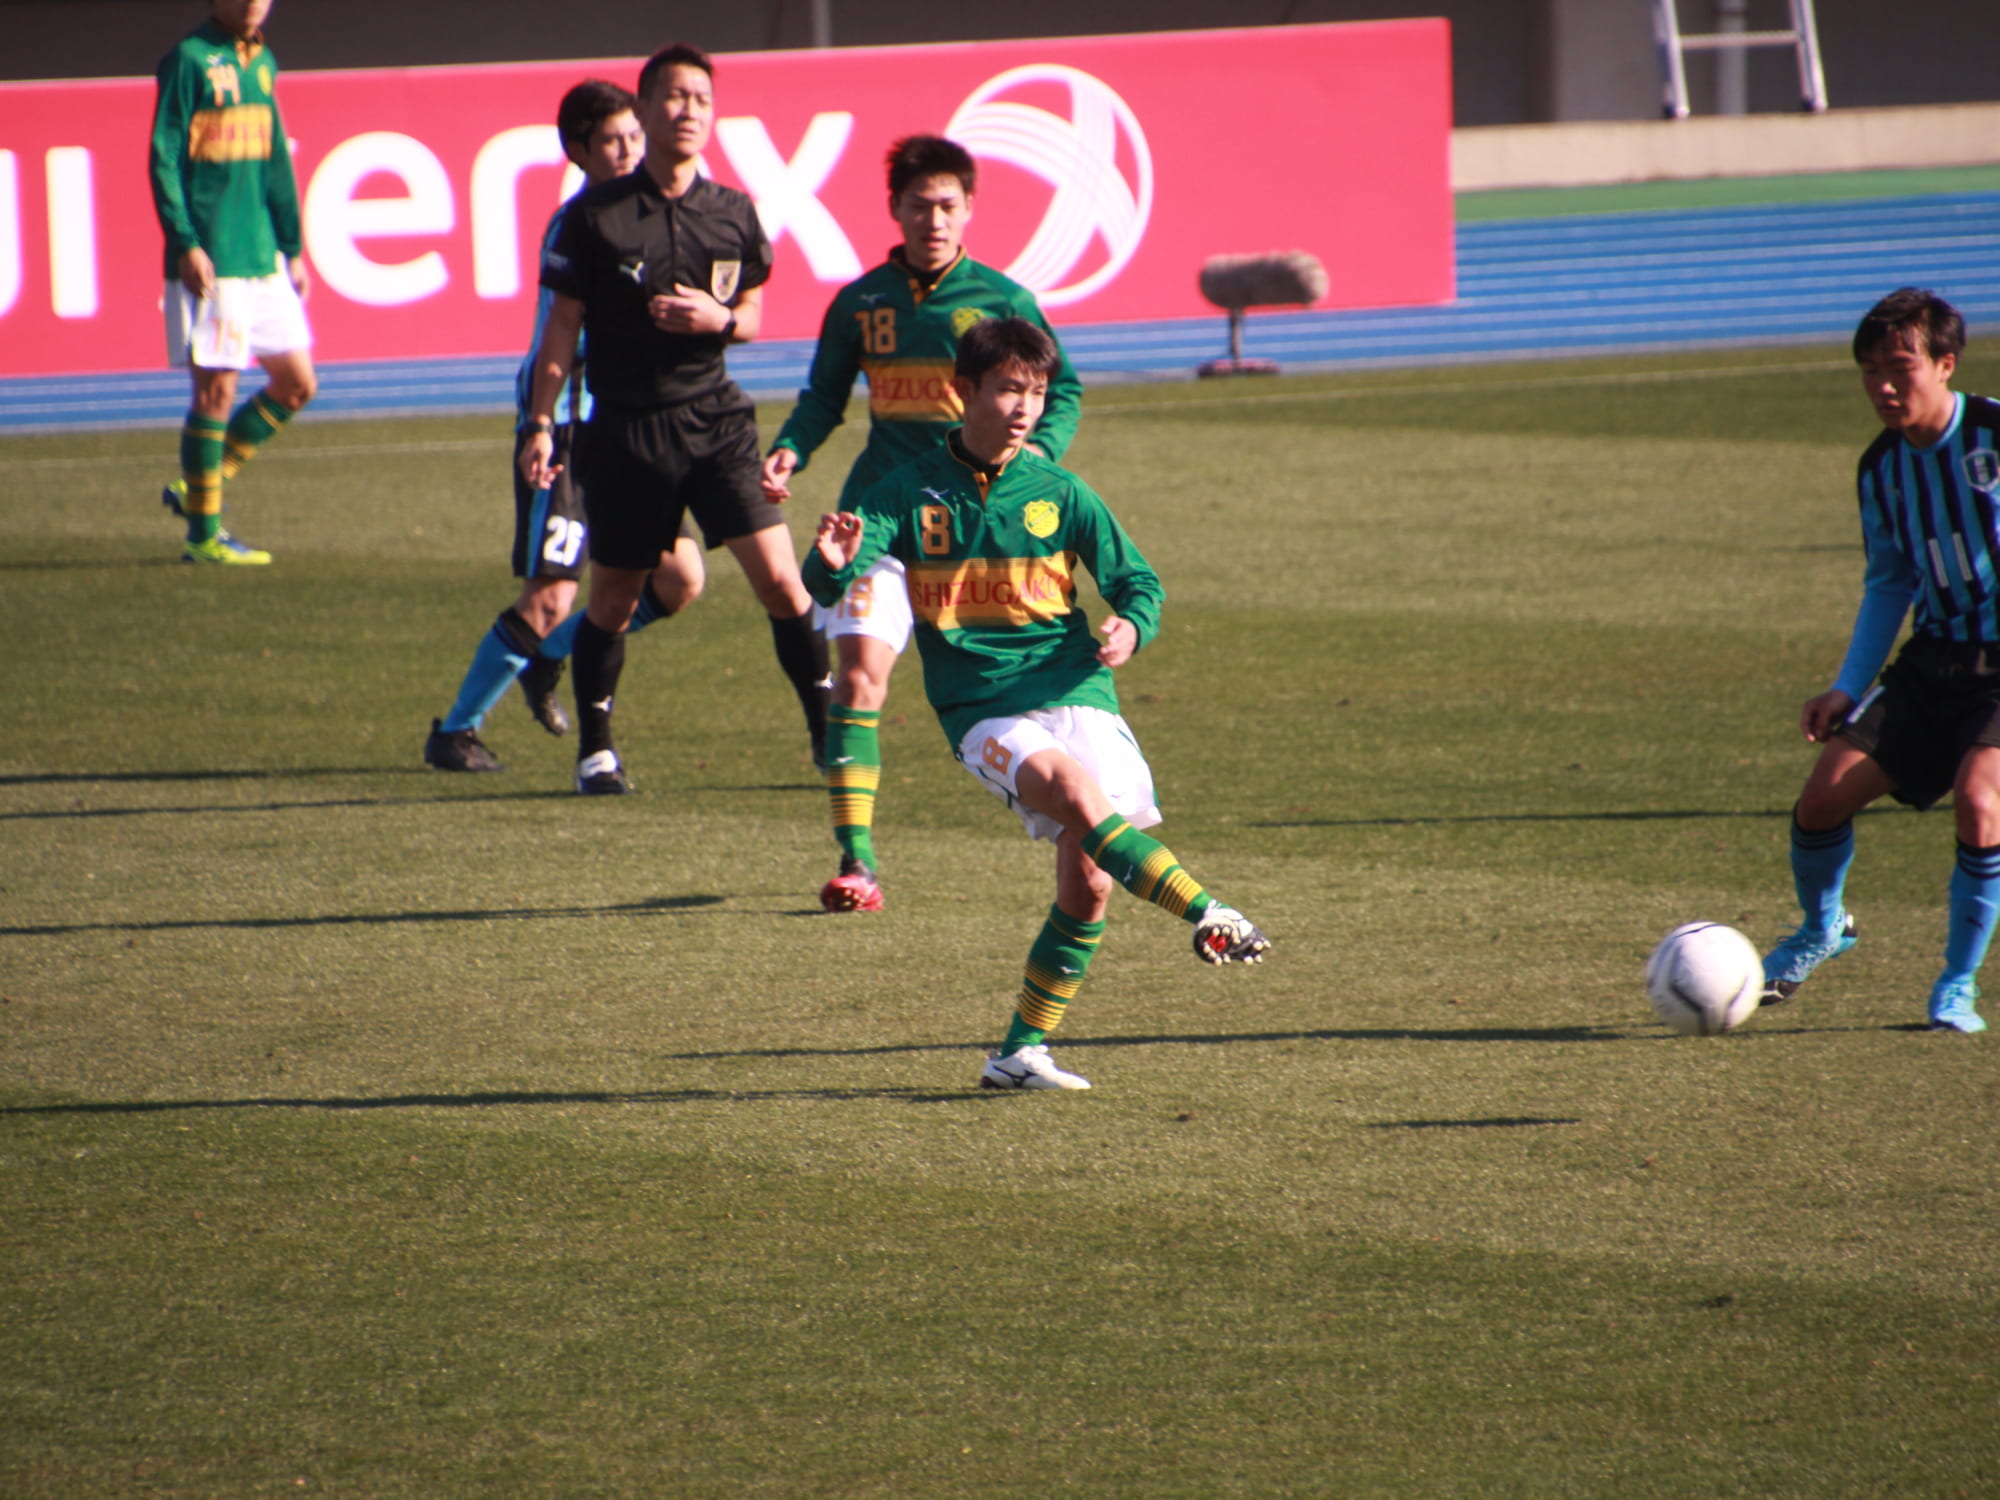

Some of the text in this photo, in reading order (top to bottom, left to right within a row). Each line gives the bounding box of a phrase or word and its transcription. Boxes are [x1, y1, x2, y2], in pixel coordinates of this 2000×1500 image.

[206, 64, 240, 106] 14
[853, 307, 896, 354] 18
[922, 504, 950, 555] 8
[911, 574, 1064, 608] SHIZUGAKU
[982, 735, 1013, 777] 8
